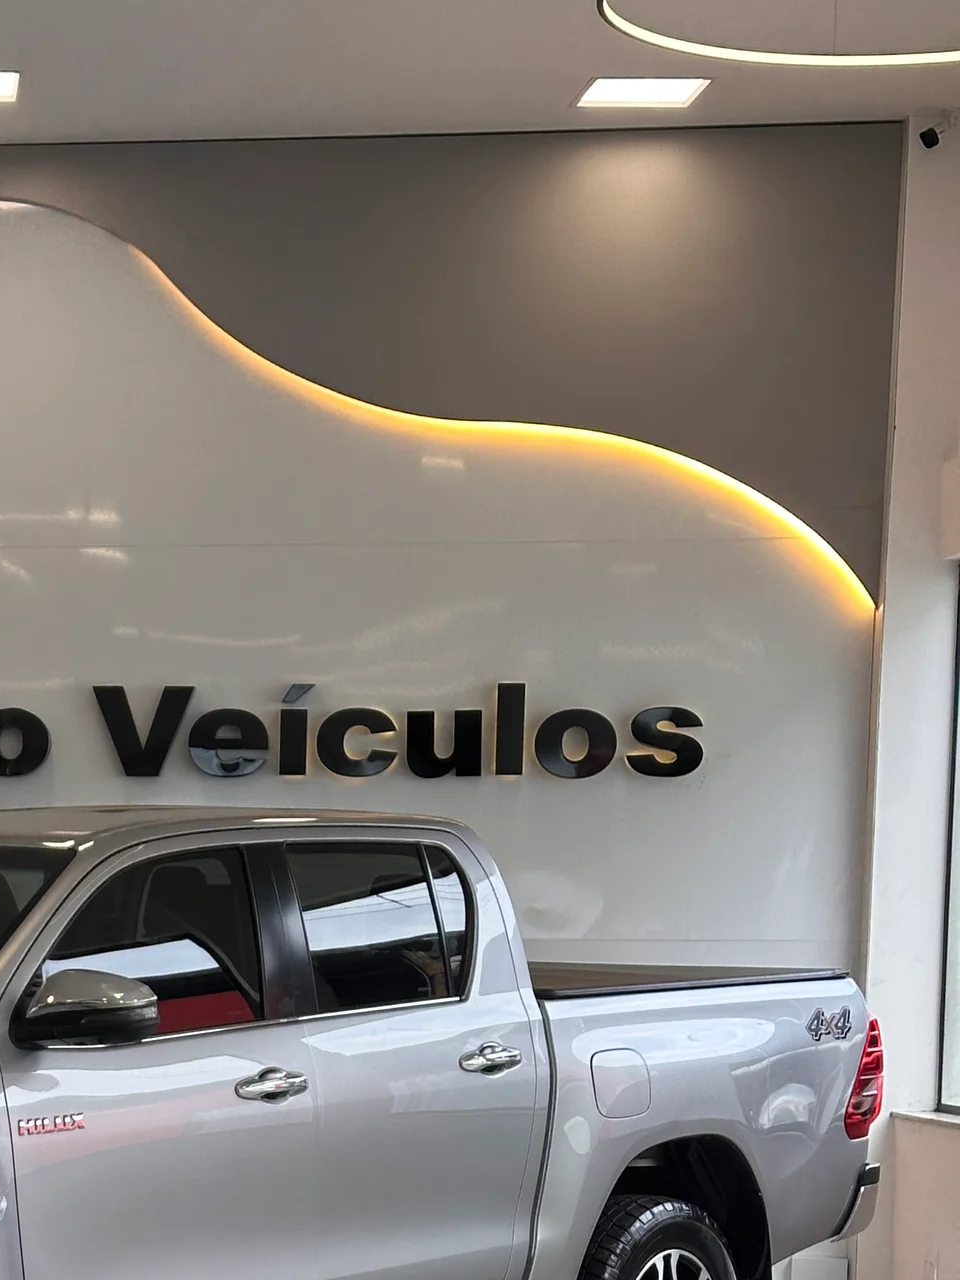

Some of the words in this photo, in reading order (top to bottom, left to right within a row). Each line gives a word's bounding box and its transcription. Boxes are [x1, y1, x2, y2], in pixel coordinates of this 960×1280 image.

[92, 682, 706, 779] Veículos
[805, 1006, 852, 1041] 4x4
[17, 1111, 85, 1136] HILUX
